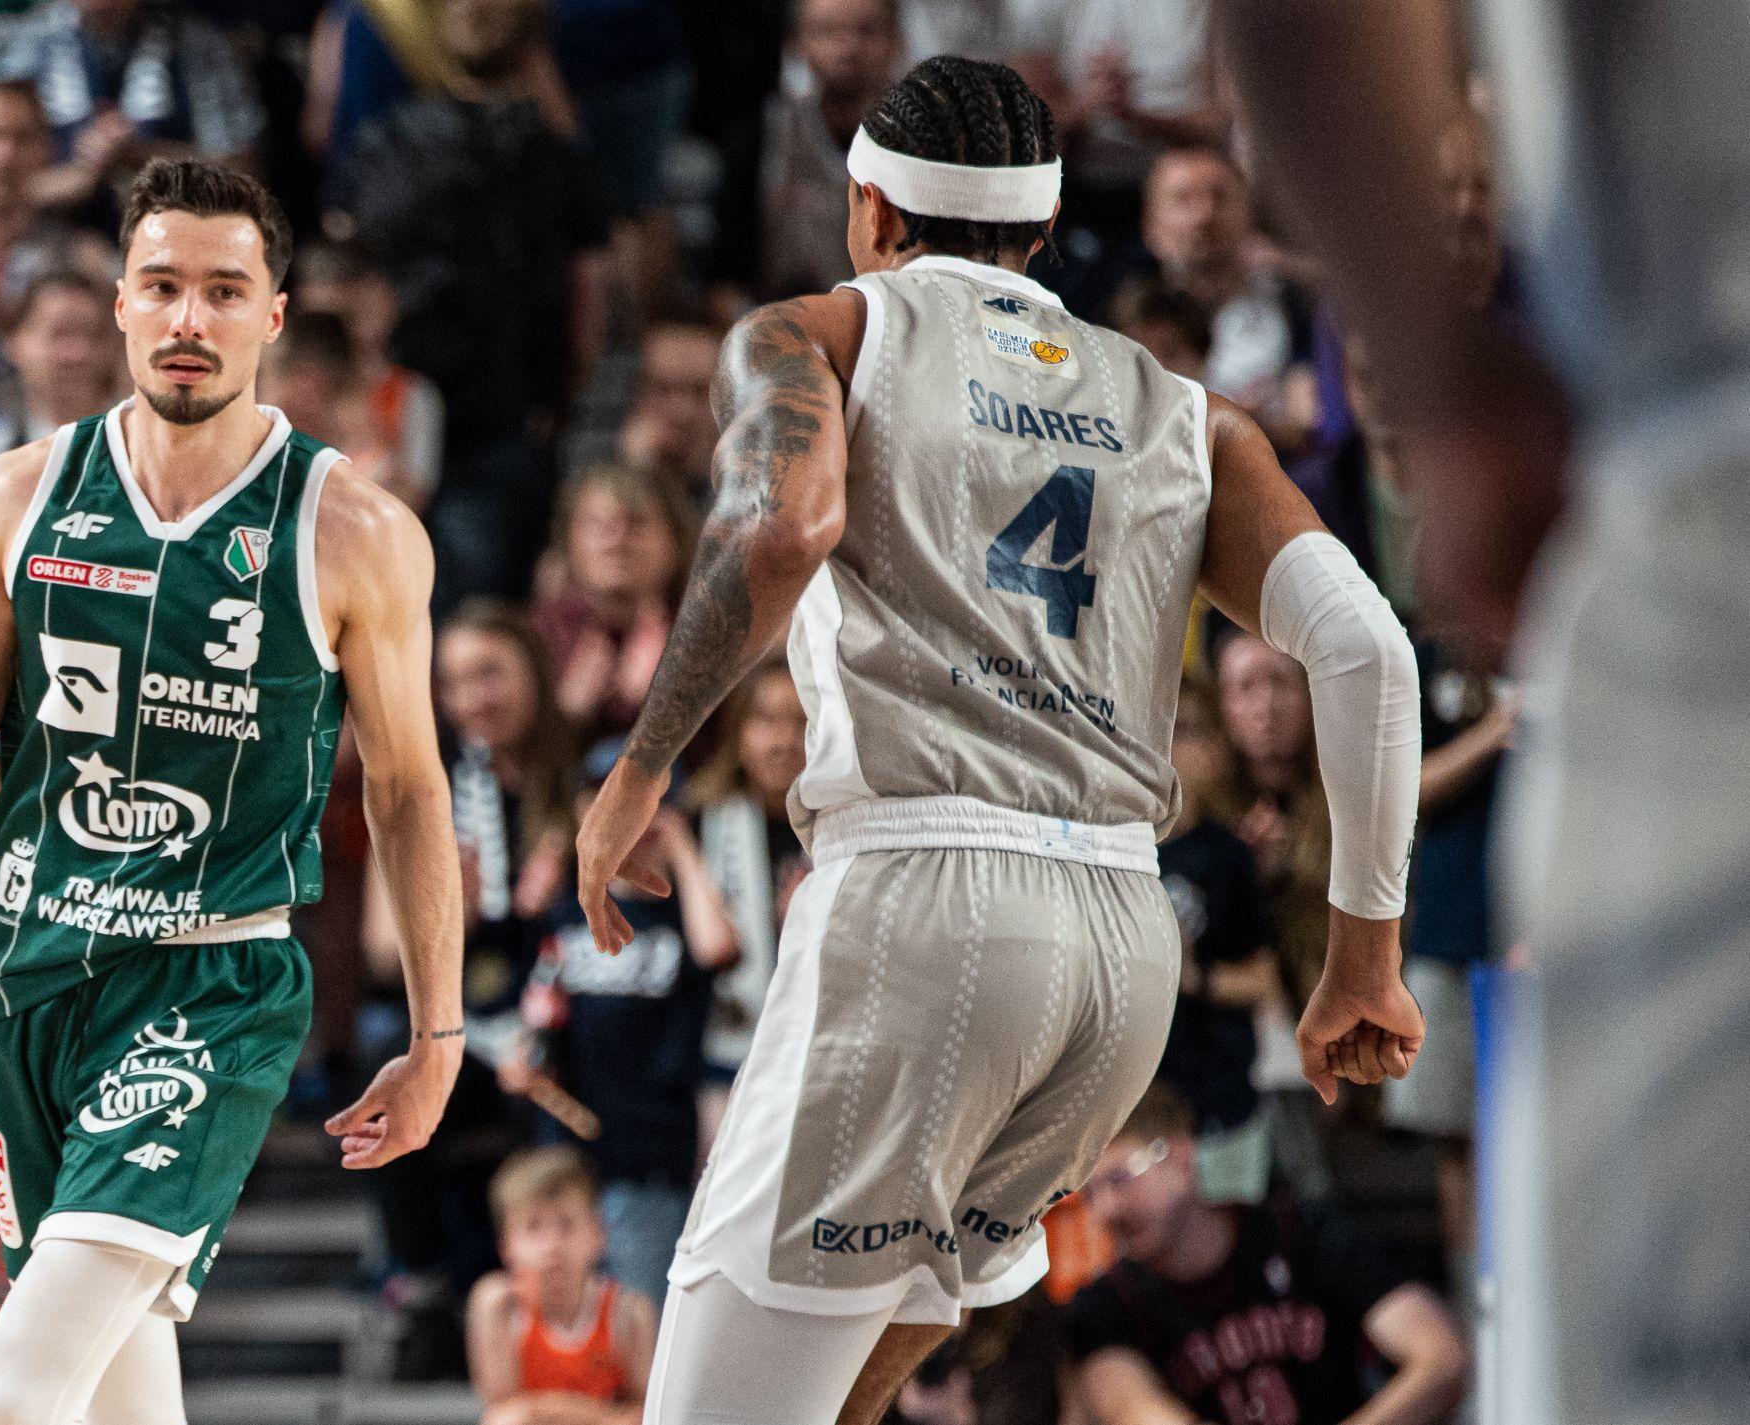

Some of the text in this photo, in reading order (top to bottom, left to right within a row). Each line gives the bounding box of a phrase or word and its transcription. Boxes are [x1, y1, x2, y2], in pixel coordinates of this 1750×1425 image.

[968, 379, 1124, 453] SOARES
[51, 511, 114, 540] 4F
[32, 561, 152, 583] ORLEN Basket
[986, 464, 1097, 640] 4
[203, 598, 264, 671] 3
[139, 672, 260, 714] ORLEN
[139, 703, 261, 741] TERMIKA
[86, 789, 179, 838] LOTTO
[62, 876, 203, 914] TRAMWAJE
[100, 1079, 181, 1120] LOTTO
[122, 1141, 181, 1172] 4F
